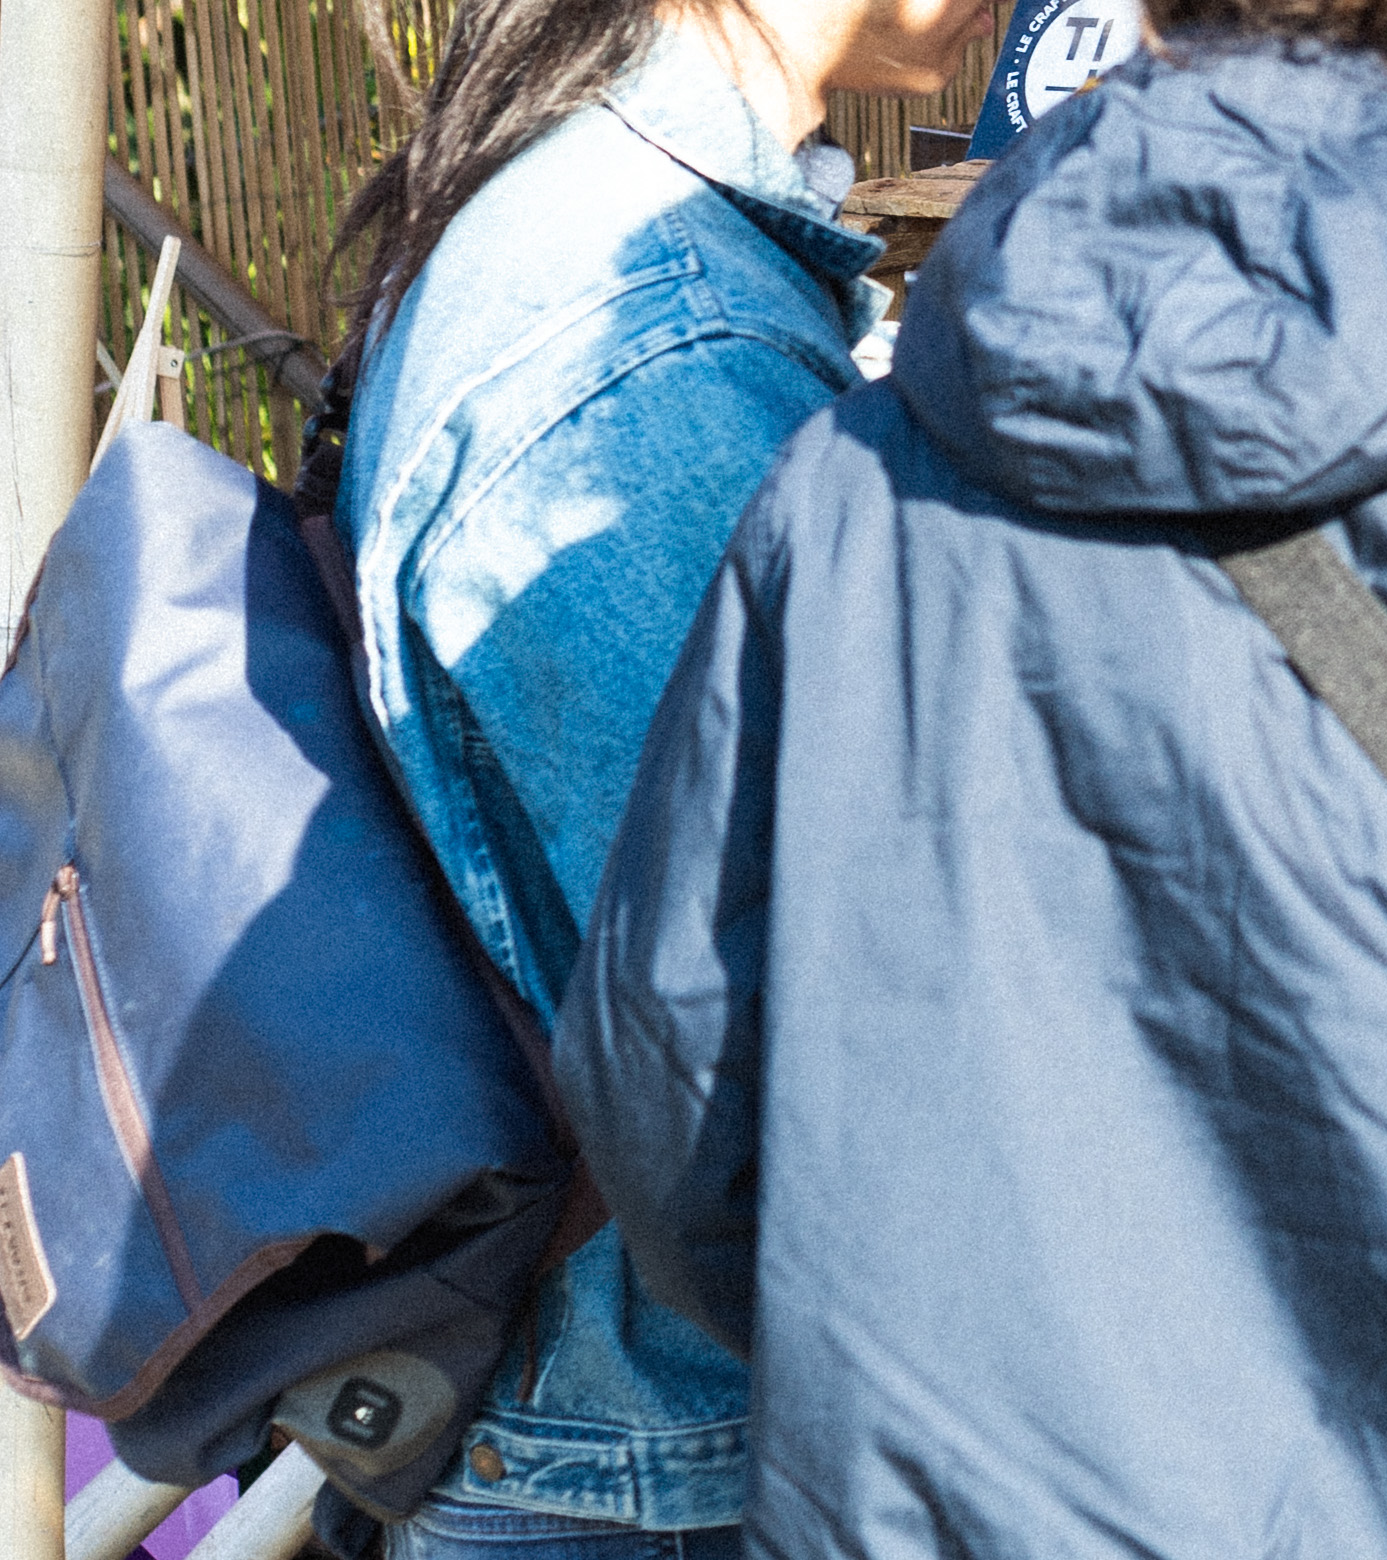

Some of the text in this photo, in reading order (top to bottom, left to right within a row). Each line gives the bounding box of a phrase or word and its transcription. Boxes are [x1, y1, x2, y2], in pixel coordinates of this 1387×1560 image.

[1016, 34, 1033, 53] LE
[1066, 16, 1115, 62] TI
[1005, 71, 1029, 133] LE CRAFT
